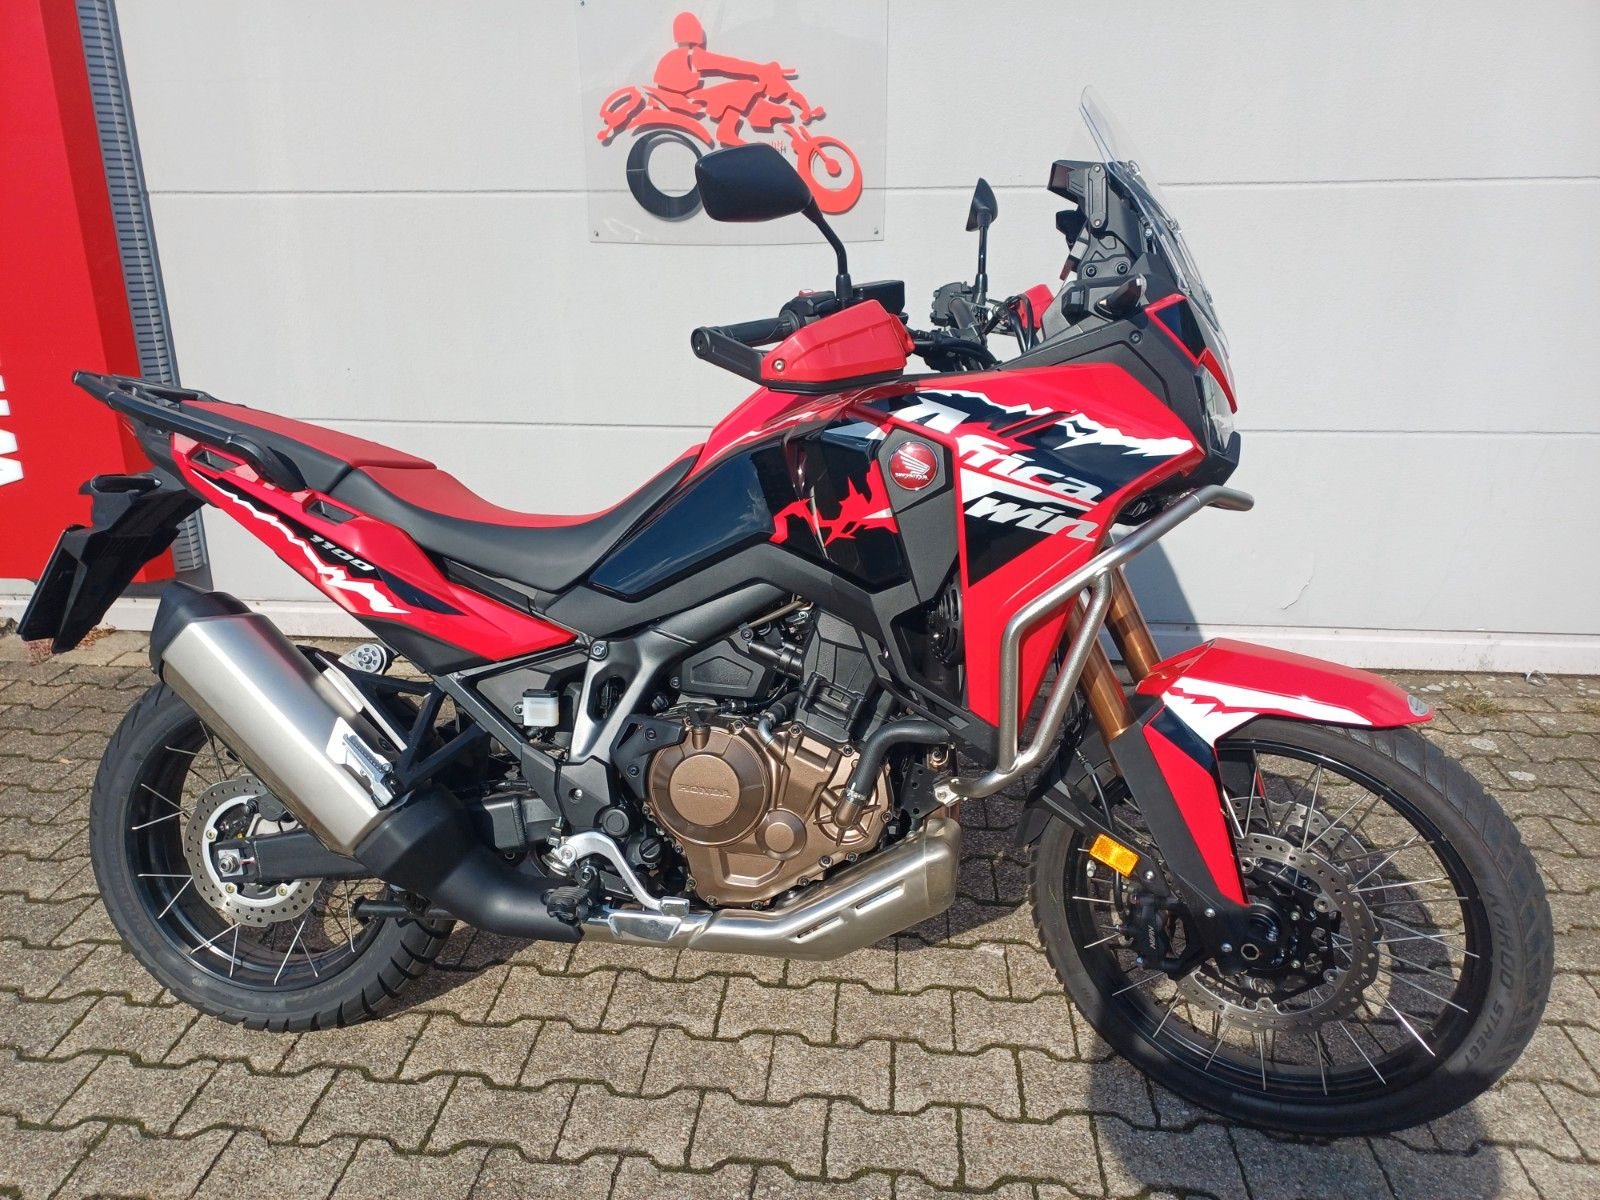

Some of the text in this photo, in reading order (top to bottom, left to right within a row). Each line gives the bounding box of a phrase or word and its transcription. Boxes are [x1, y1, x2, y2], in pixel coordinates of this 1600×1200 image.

[310, 534, 375, 571] 1100
[677, 783, 732, 799] HONDA
[1464, 891, 1516, 1065] KAROO STREET
